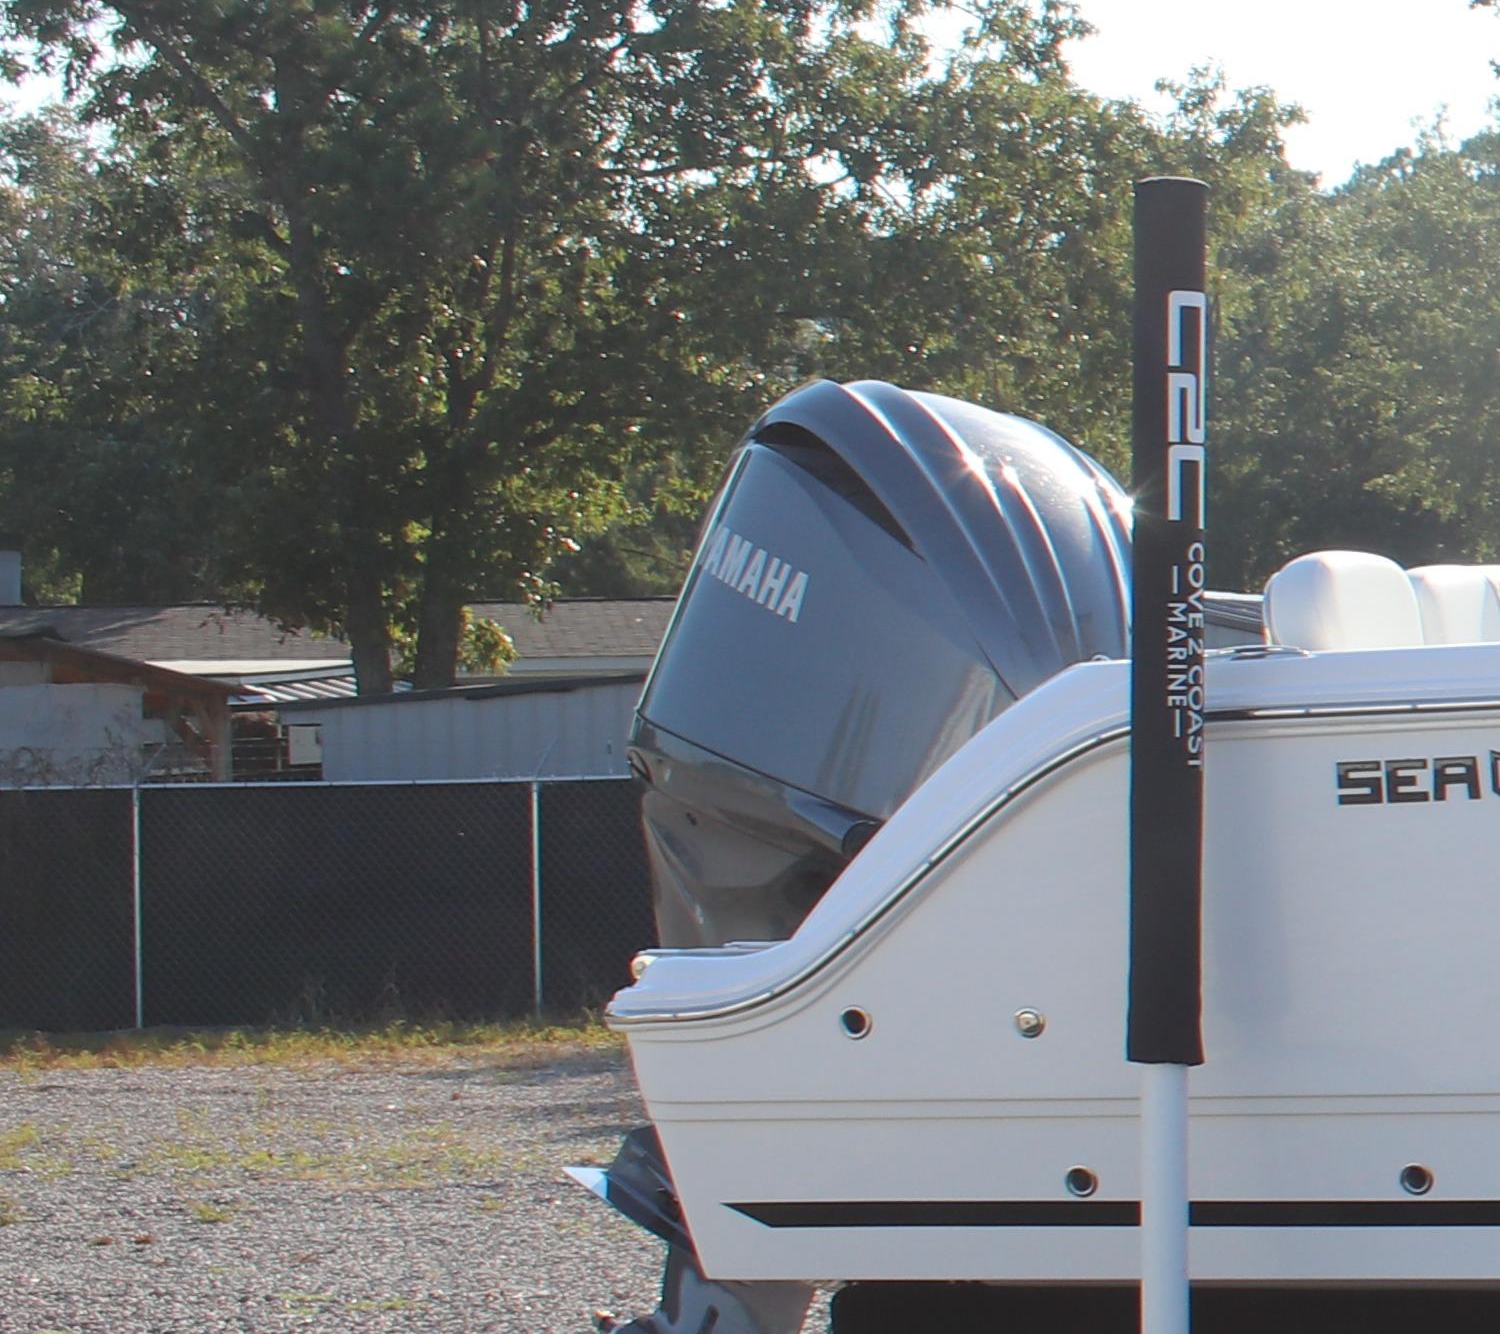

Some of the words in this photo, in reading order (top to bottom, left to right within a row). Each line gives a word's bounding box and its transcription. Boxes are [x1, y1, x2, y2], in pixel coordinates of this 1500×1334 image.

[1168, 290, 1205, 529] C2C
[700, 524, 809, 623] AMAHA
[1187, 542, 1205, 628] COVE
[1167, 603, 1187, 707] MARINE
[1188, 638, 1205, 656] 2
[1336, 755, 1482, 806] SEA
